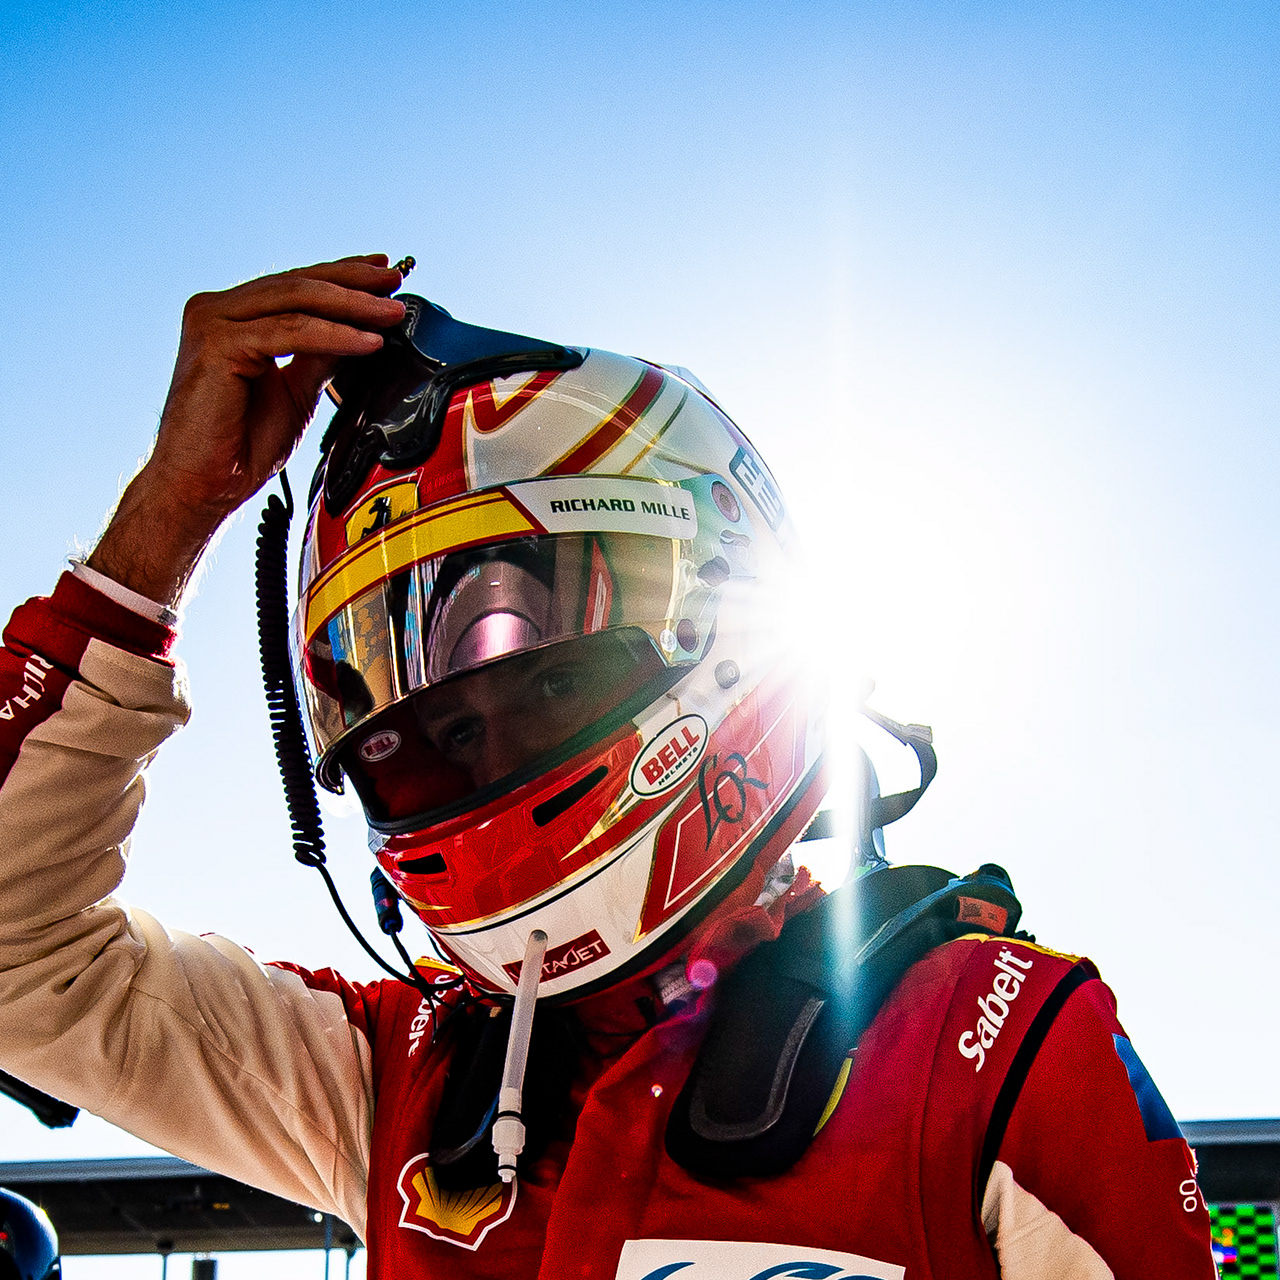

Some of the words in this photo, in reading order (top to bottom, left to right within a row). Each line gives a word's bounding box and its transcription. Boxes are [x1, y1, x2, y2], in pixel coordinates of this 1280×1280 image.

[549, 498, 636, 514] RICHARD
[640, 500, 691, 521] MILLE
[640, 725, 701, 787] BELL
[657, 746, 699, 787] HELMETS
[957, 949, 1034, 1073] Sabelt
